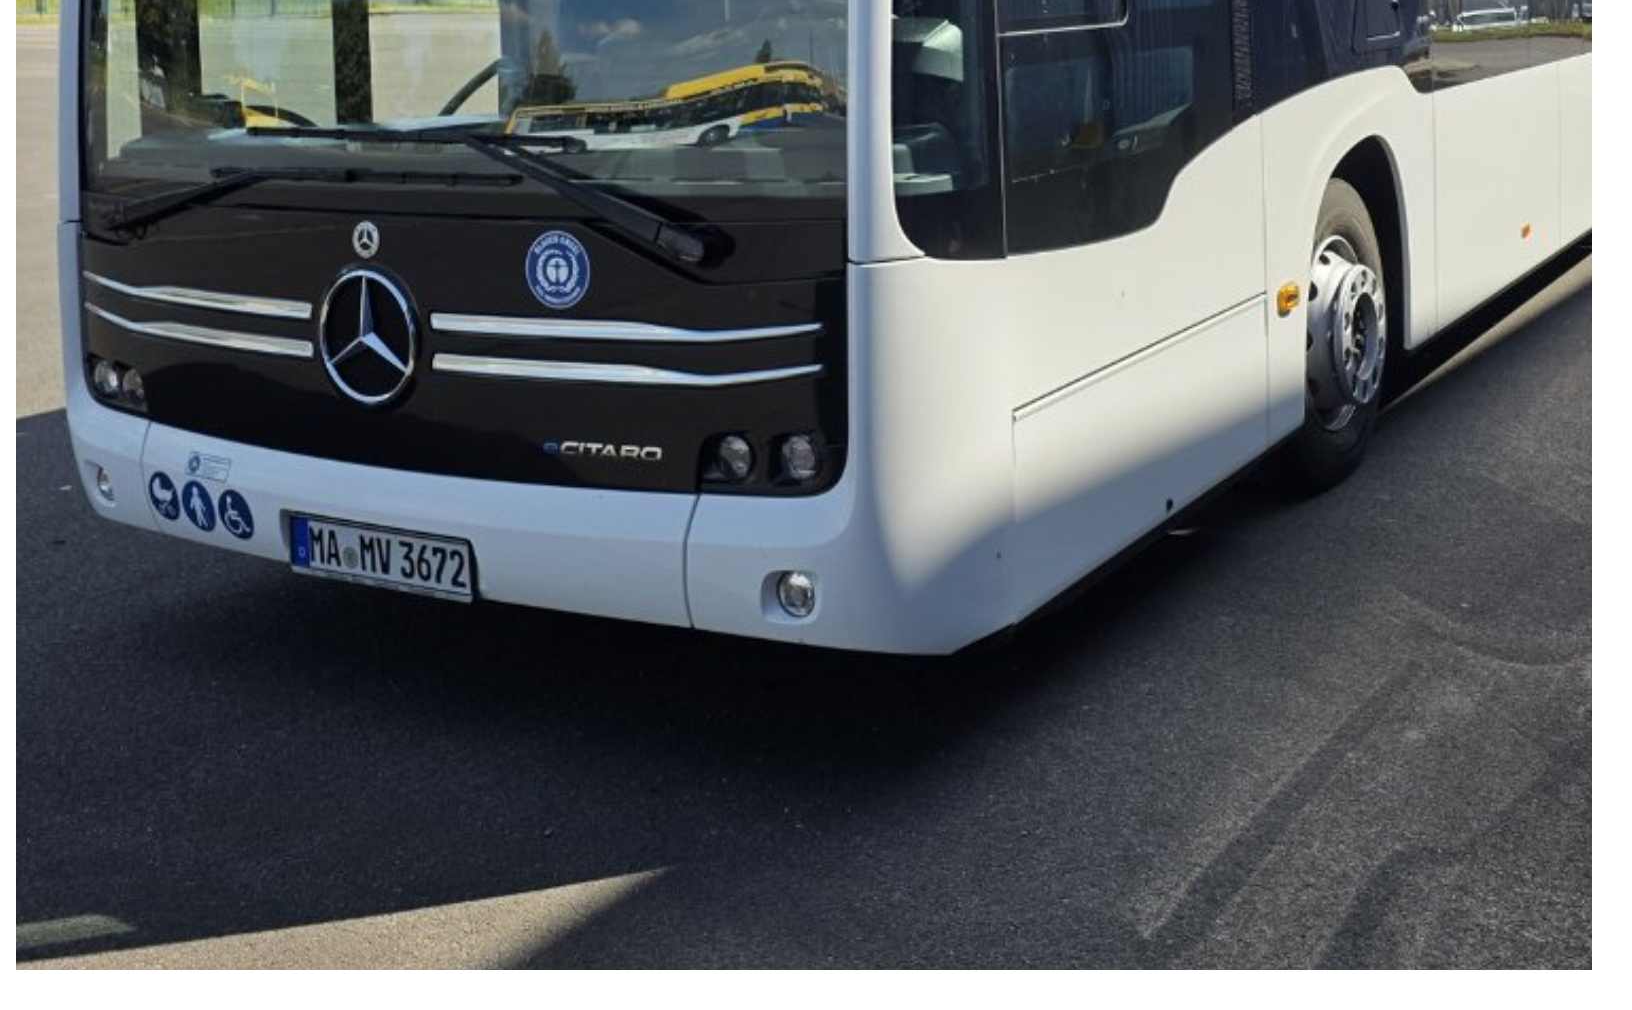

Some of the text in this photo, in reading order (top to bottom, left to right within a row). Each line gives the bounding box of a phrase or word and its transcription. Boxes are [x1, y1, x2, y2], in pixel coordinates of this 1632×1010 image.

[308, 525, 466, 588] MA MV 3672
